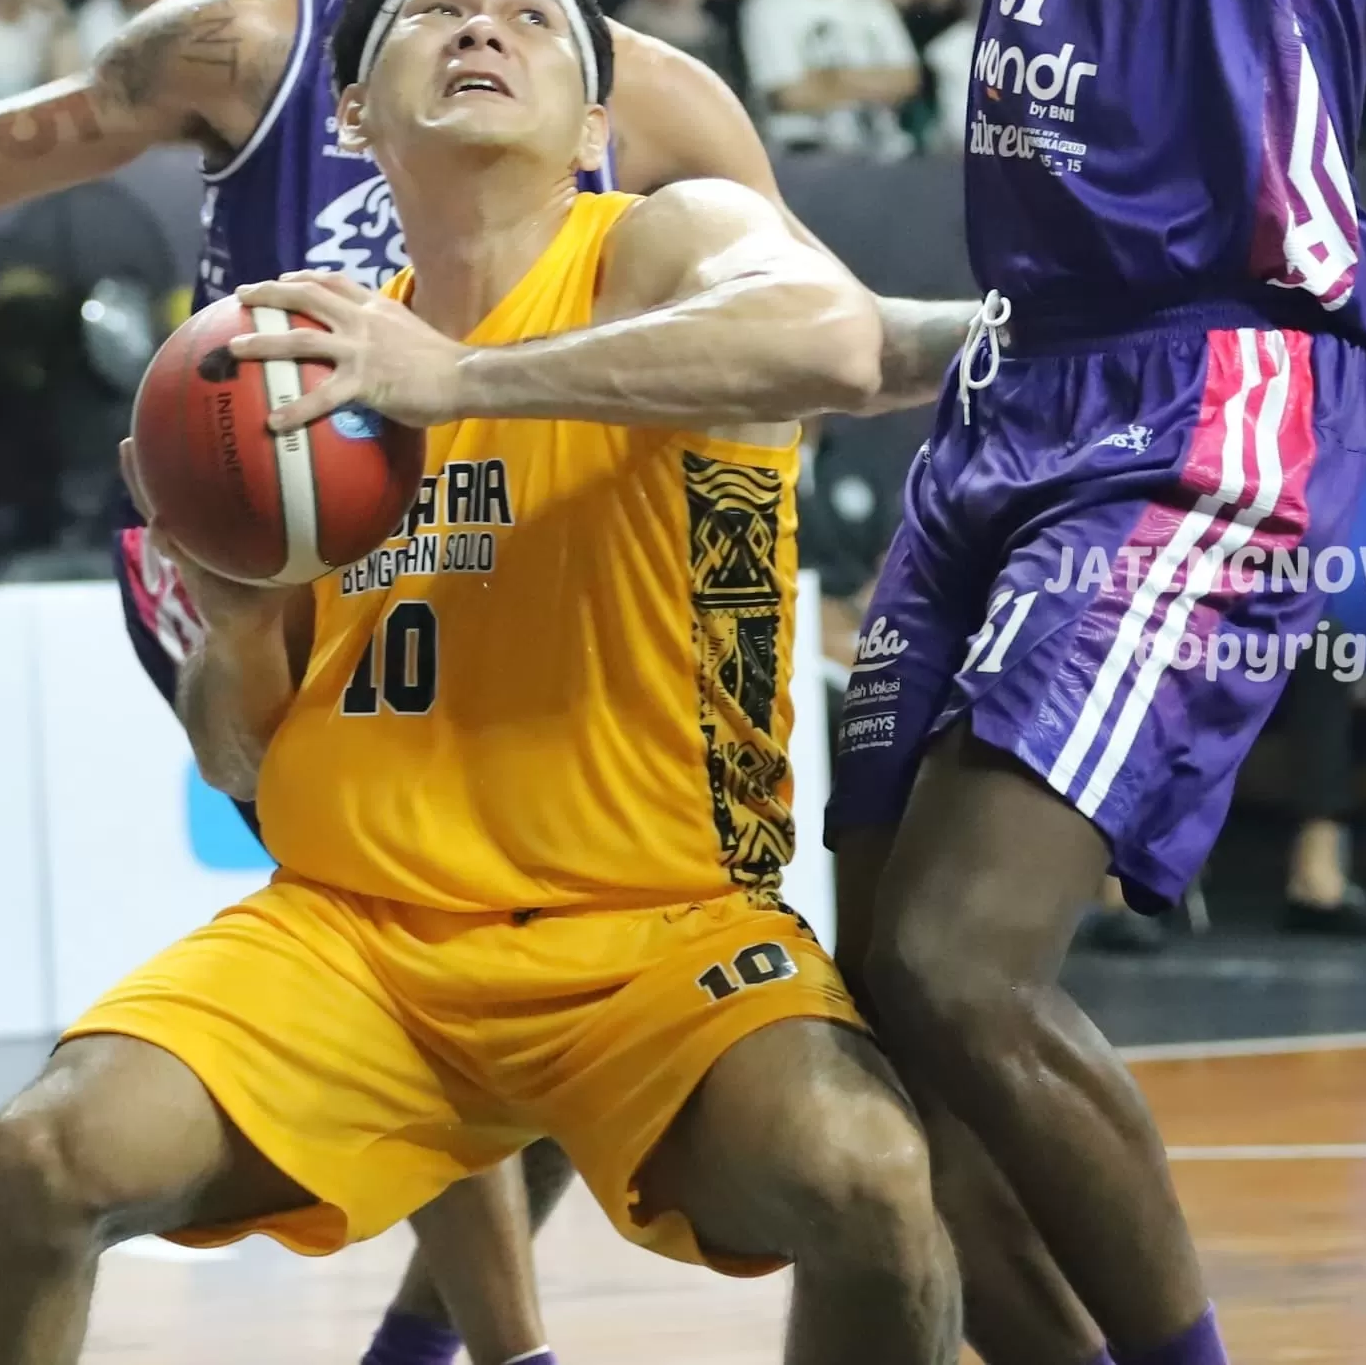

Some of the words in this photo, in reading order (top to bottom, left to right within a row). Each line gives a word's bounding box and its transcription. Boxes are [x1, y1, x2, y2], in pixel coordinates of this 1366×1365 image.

[1029, 101, 1048, 119] by
[1049, 105, 1075, 123] BNI
[340, 599, 439, 717] 10
[695, 941, 799, 1004] 10
